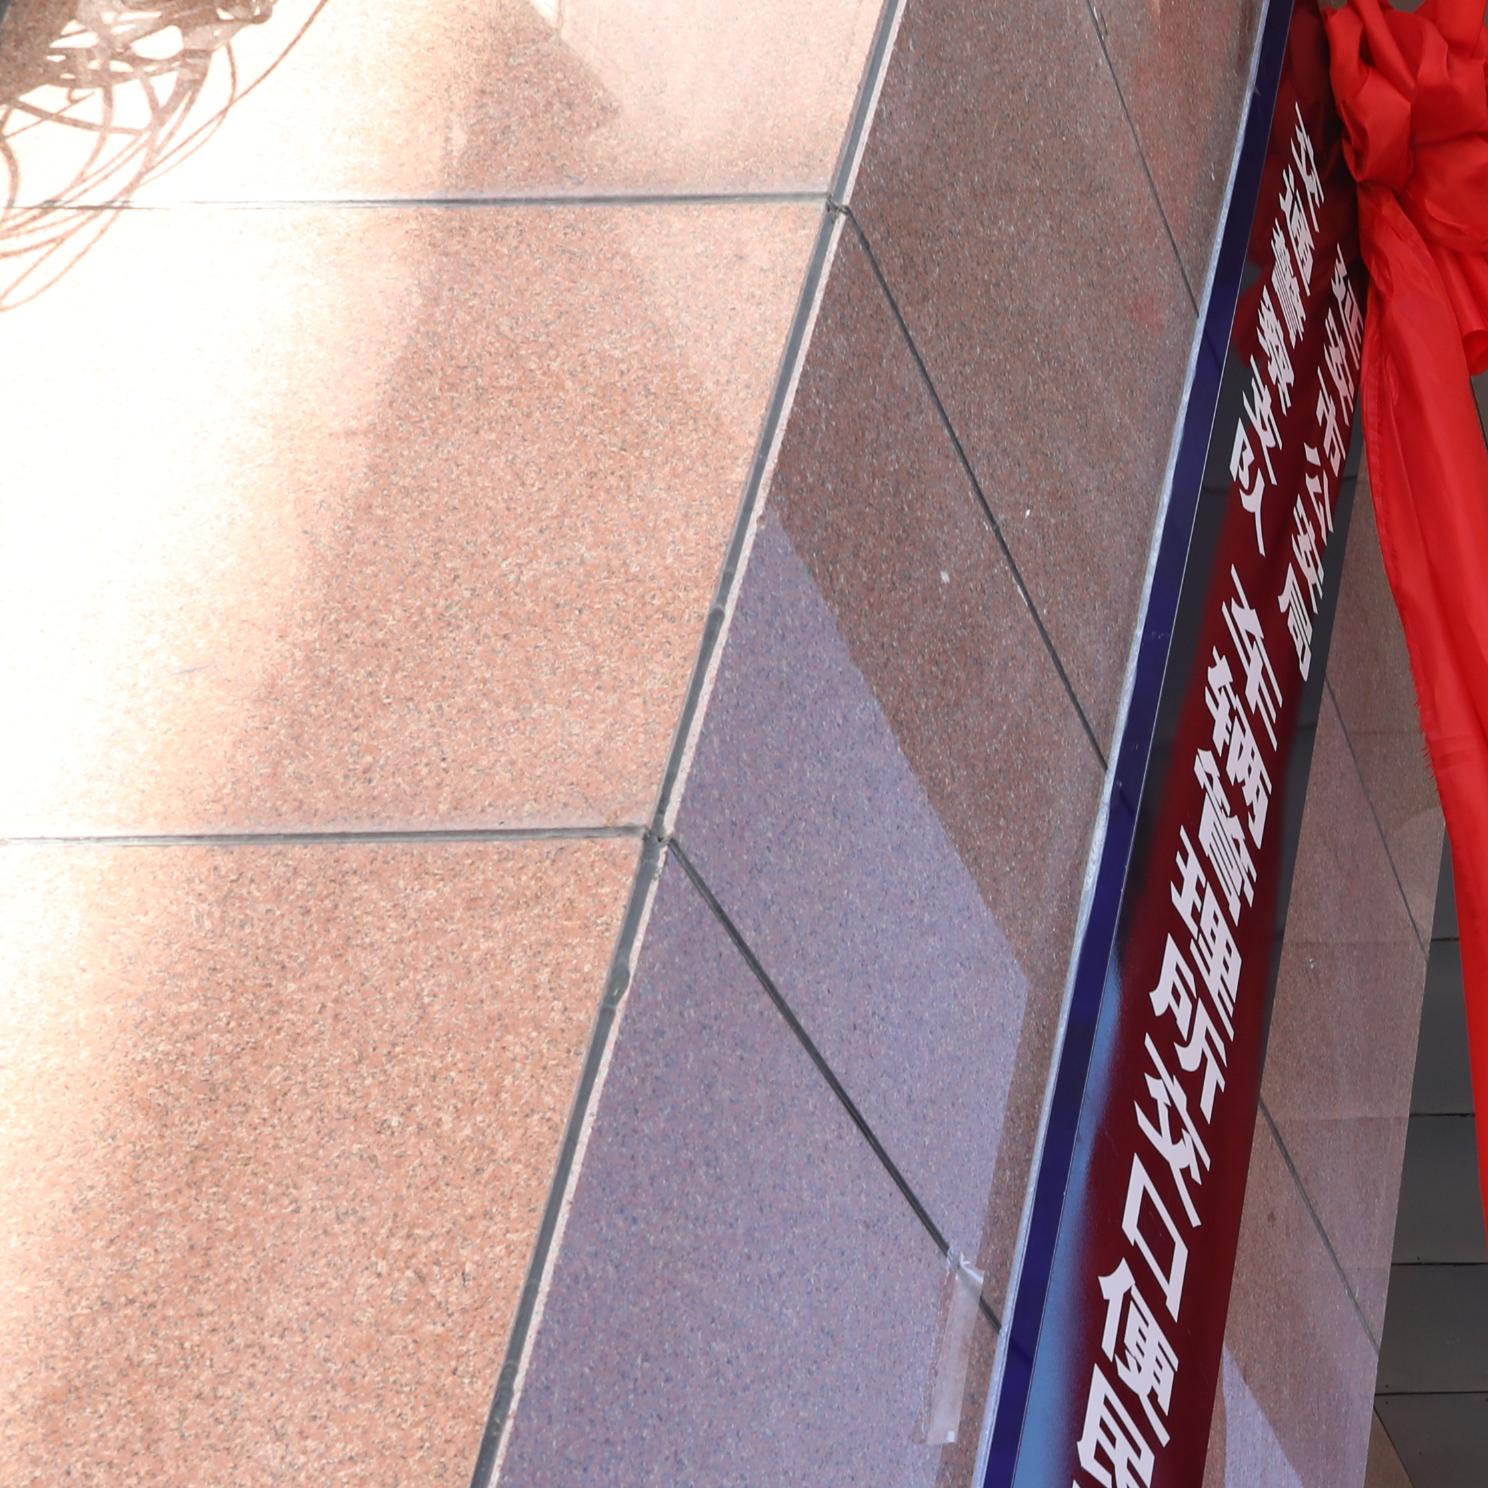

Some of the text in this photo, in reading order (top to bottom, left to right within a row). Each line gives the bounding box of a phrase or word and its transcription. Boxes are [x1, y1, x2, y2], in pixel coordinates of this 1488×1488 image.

[1230, 102, 1325, 556] 交通警察支队
[1278, 243, 1364, 682] 延安市公安局
